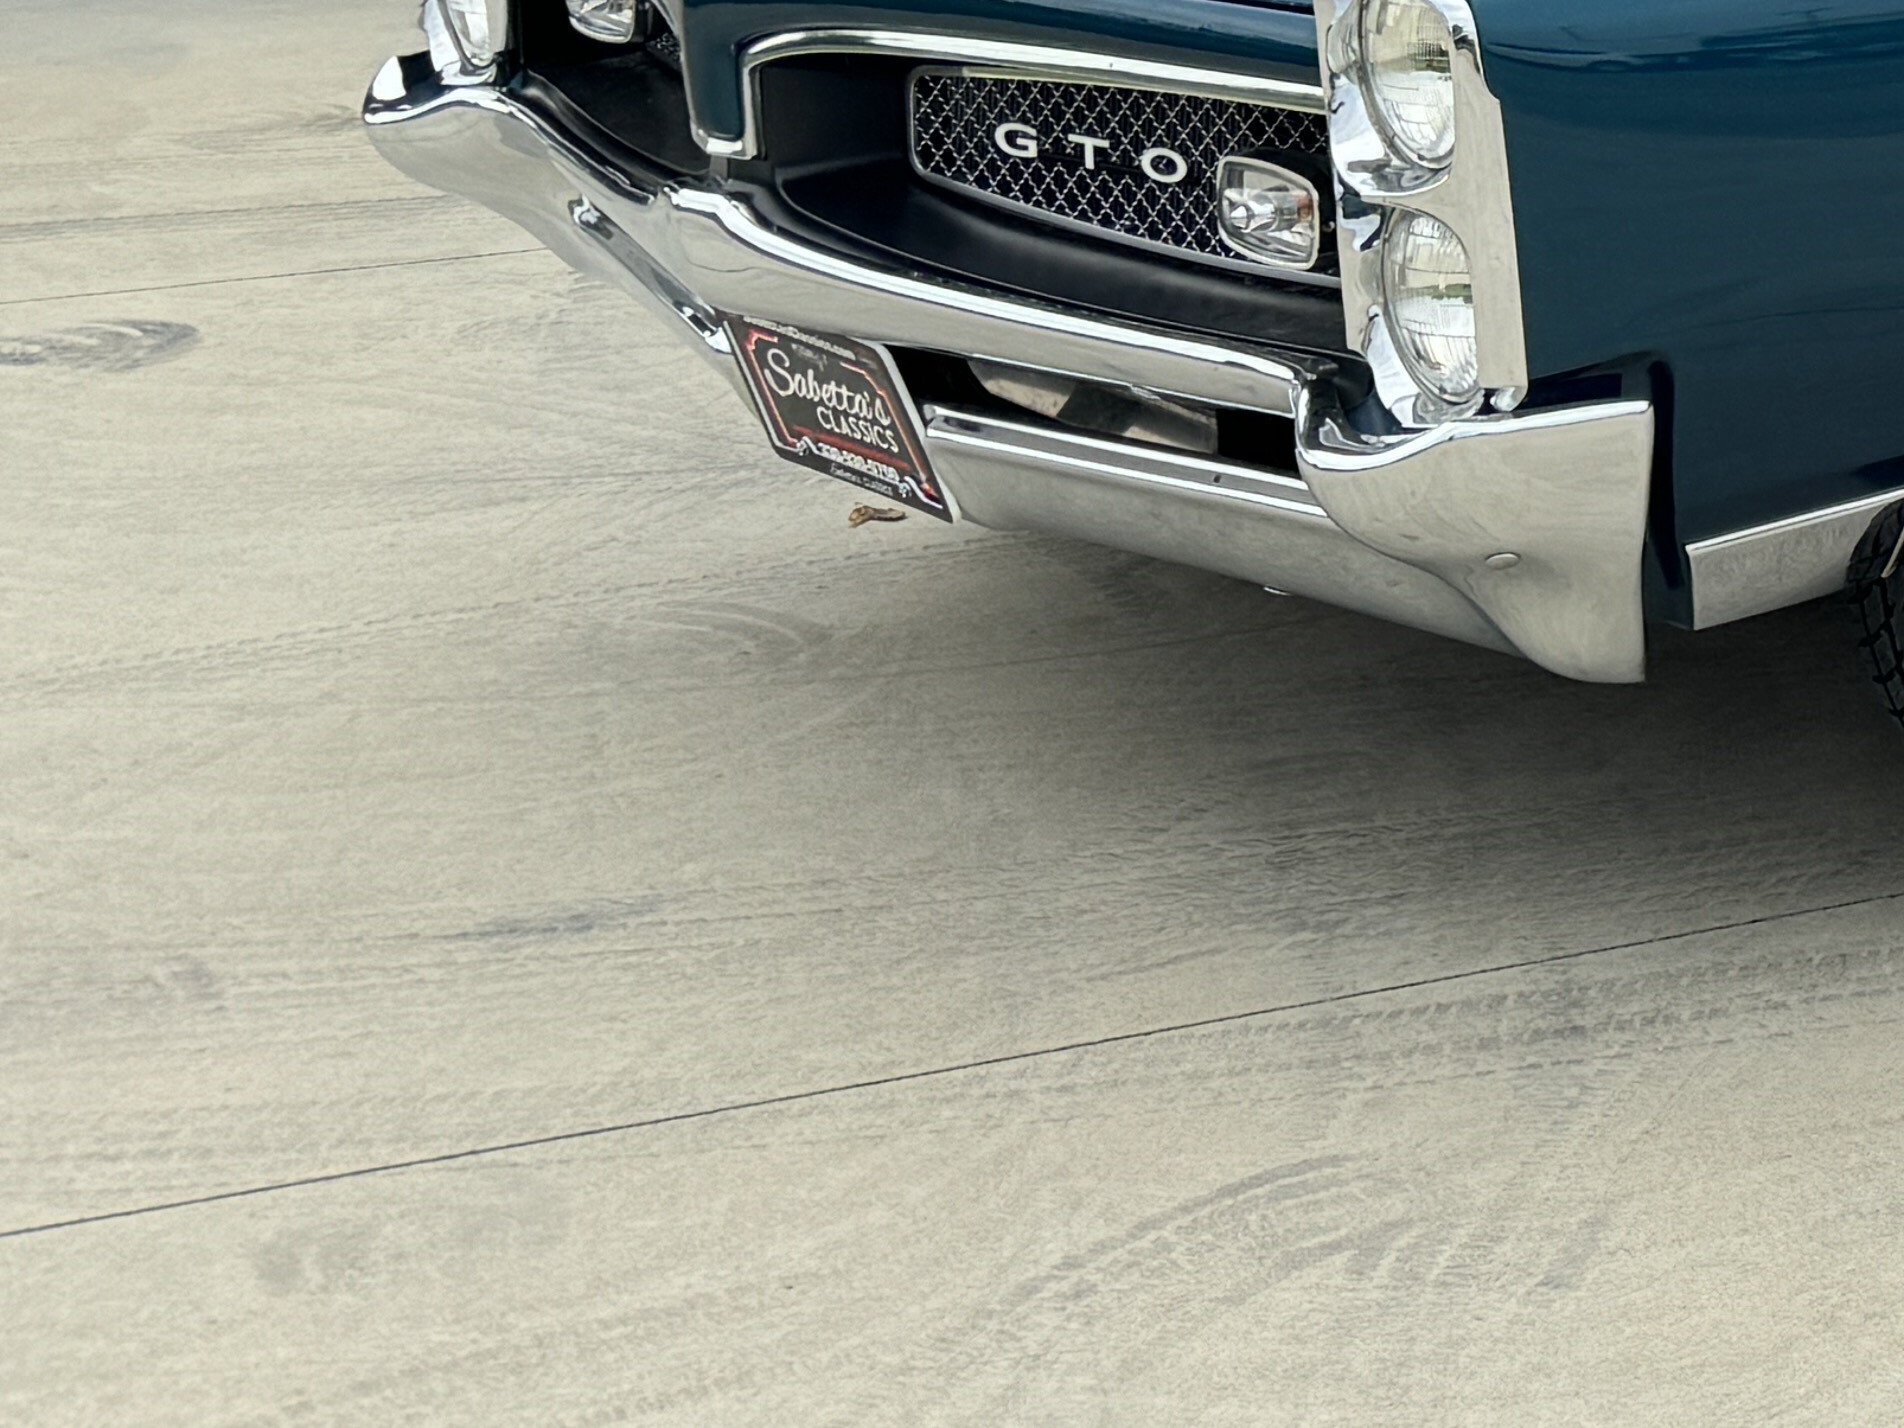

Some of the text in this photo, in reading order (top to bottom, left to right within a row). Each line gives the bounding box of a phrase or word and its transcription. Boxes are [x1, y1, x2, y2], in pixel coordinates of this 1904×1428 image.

[994, 122, 1188, 184] GTO
[764, 348, 891, 426] Sabetta's
[816, 405, 899, 453] CLASSICS
